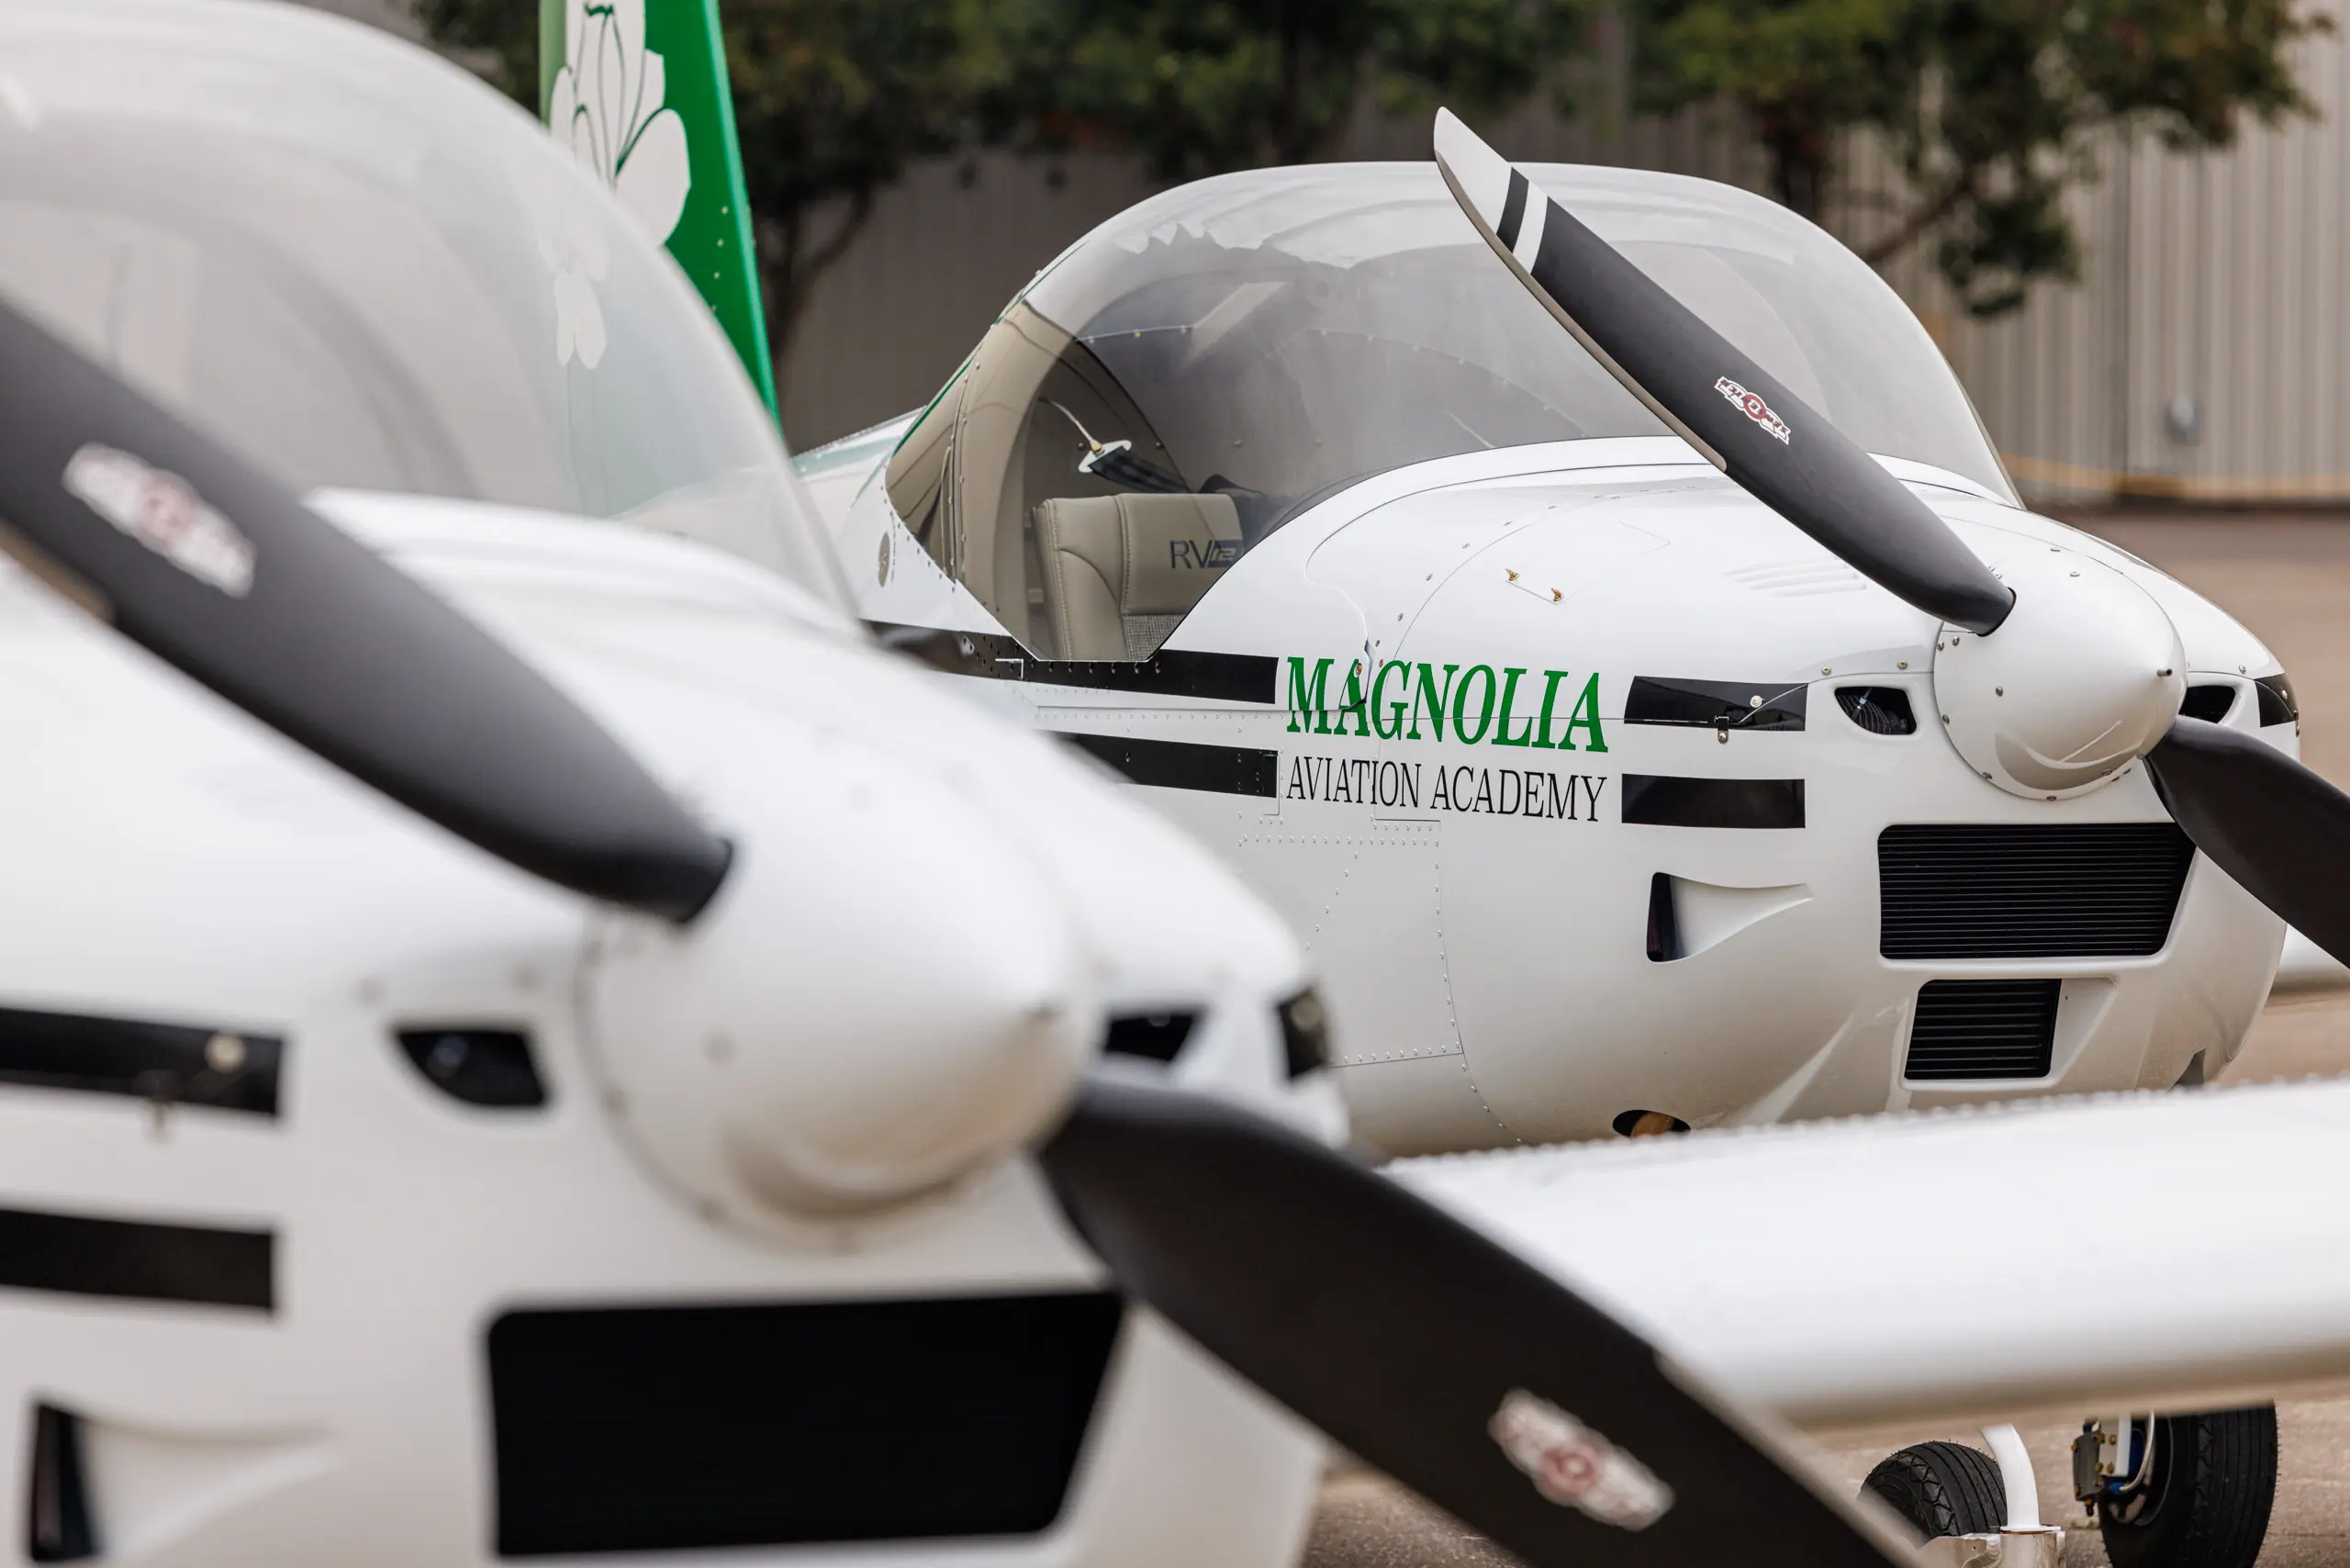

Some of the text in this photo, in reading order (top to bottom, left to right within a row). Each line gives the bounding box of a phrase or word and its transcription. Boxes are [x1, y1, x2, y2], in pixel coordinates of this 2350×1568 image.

[1287, 656, 1608, 753] MAGNOLIA
[1286, 756, 1607, 822] AVIATION ACADEMY
